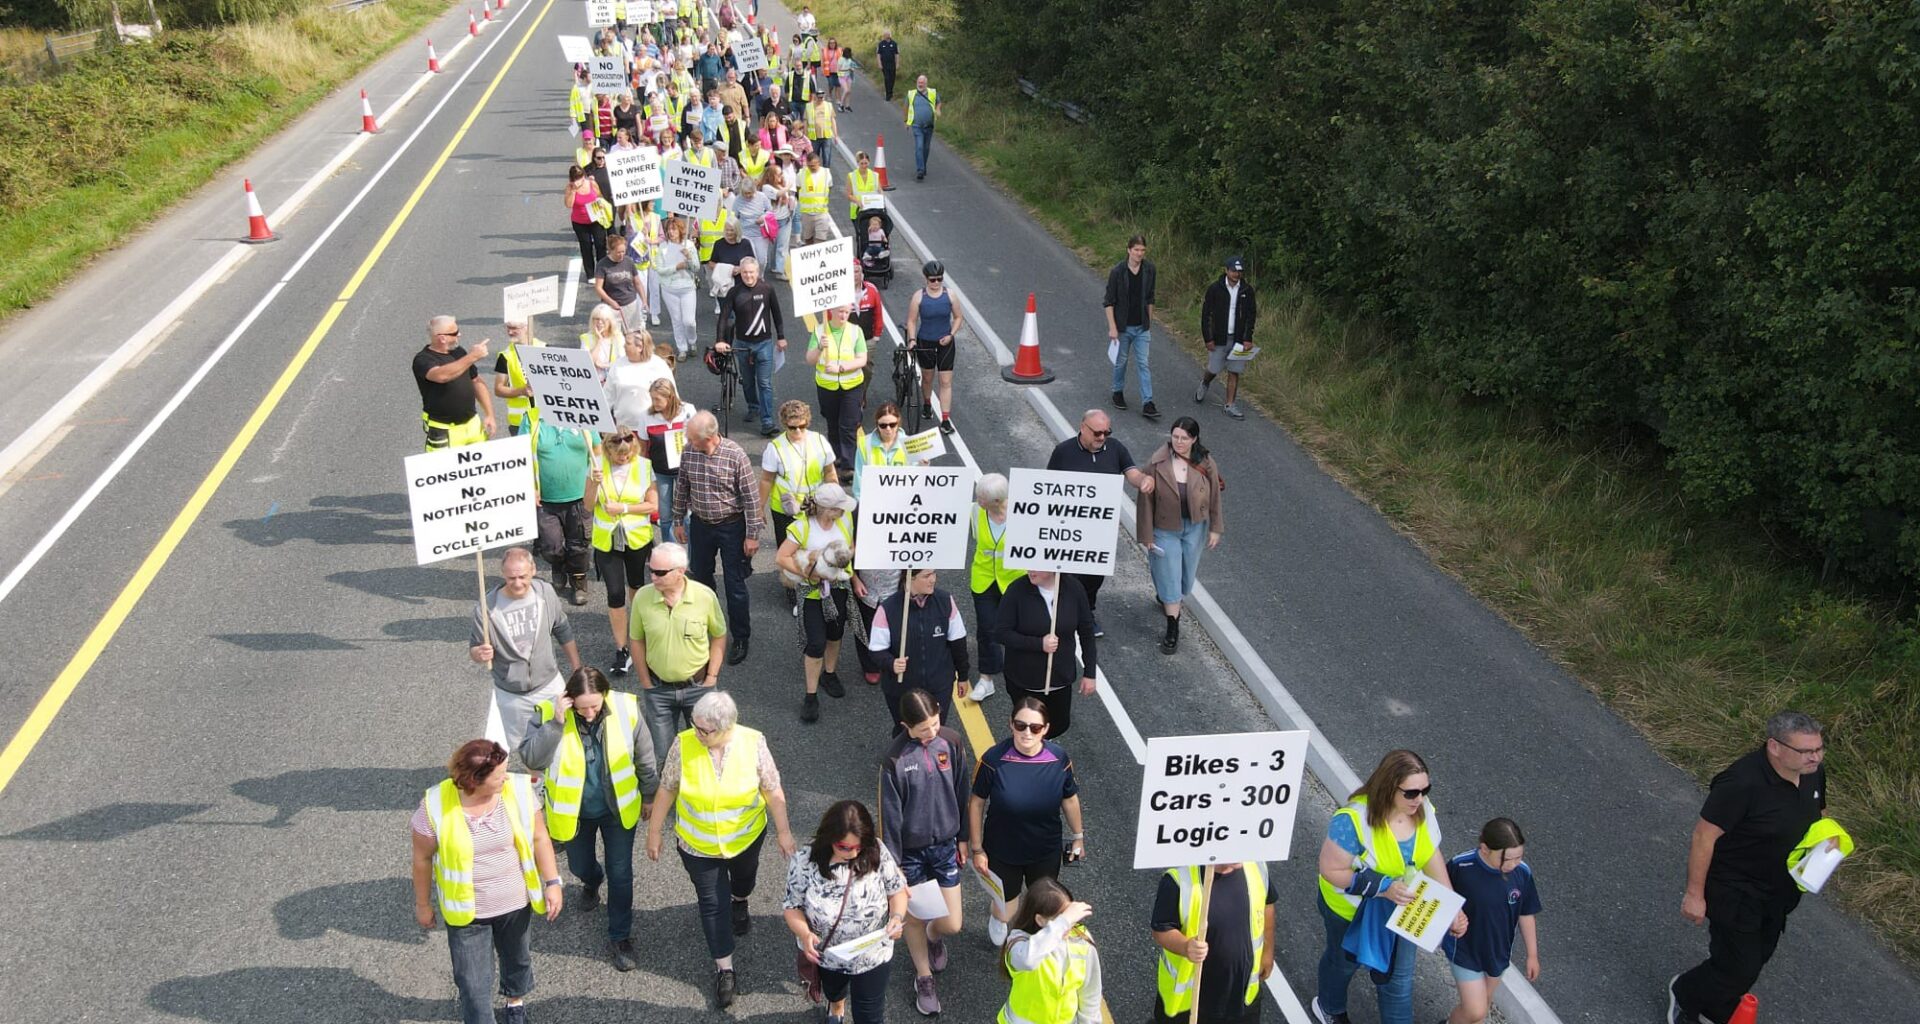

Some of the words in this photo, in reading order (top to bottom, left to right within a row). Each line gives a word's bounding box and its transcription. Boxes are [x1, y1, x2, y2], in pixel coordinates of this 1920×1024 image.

[617, 154, 646, 165] STARTS
[611, 168, 623, 178] NO
[626, 162, 656, 174] WHERE
[682, 166, 706, 178] WHO
[626, 177, 646, 188] ENDS
[670, 176, 690, 187] LET
[694, 181, 714, 192] THE
[616, 190, 628, 200] NO
[631, 186, 661, 197] WHERE
[675, 190, 706, 203] BIKES
[678, 202, 700, 214] OUT
[800, 248, 822, 260] WHY
[826, 244, 844, 254] NOT
[820, 260, 827, 268] A
[800, 268, 847, 286] UNICORN
[810, 282, 838, 296] LANE
[812, 295, 838, 308] TOO?
[542, 352, 568, 362] FROM
[529, 364, 556, 375] SAFE
[562, 366, 592, 379] ROAD
[559, 382, 572, 392] TO
[543, 394, 600, 410] DEATH
[553, 410, 600, 426] TRAP
[458, 451, 482, 464] No
[415, 458, 527, 488] CONSULTATION
[878, 474, 918, 487] WHY
[924, 475, 959, 486] NOT
[461, 486, 486, 499] No
[1033, 482, 1096, 498] STARTS
[423, 492, 526, 522] NOTIFICATION
[910, 494, 922, 506] A
[1013, 502, 1040, 516] NO
[1047, 504, 1114, 520] WHERE
[872, 513, 956, 524] UNICORN
[464, 520, 490, 534] No
[432, 537, 480, 555] CYCLE
[486, 526, 524, 544] LANE
[888, 532, 938, 544] LANE
[1038, 528, 1082, 542] ENDS
[890, 550, 934, 562] TOO?
[1010, 546, 1036, 559] NO
[1044, 548, 1110, 564] WHERE
[1165, 754, 1240, 776] Bikes
[1269, 750, 1285, 771] 3
[1150, 790, 1212, 811] Cars
[1241, 784, 1290, 806] 300
[1156, 822, 1229, 847] Logic
[1258, 818, 1274, 838] 0
[1396, 906, 1412, 926] MAKES
[1416, 880, 1428, 894] BIKE
[1406, 916, 1417, 932] SHED
[1415, 900, 1426, 916] LOOK
[1414, 918, 1428, 937] GREAT
[1426, 899, 1440, 918] VALUE
